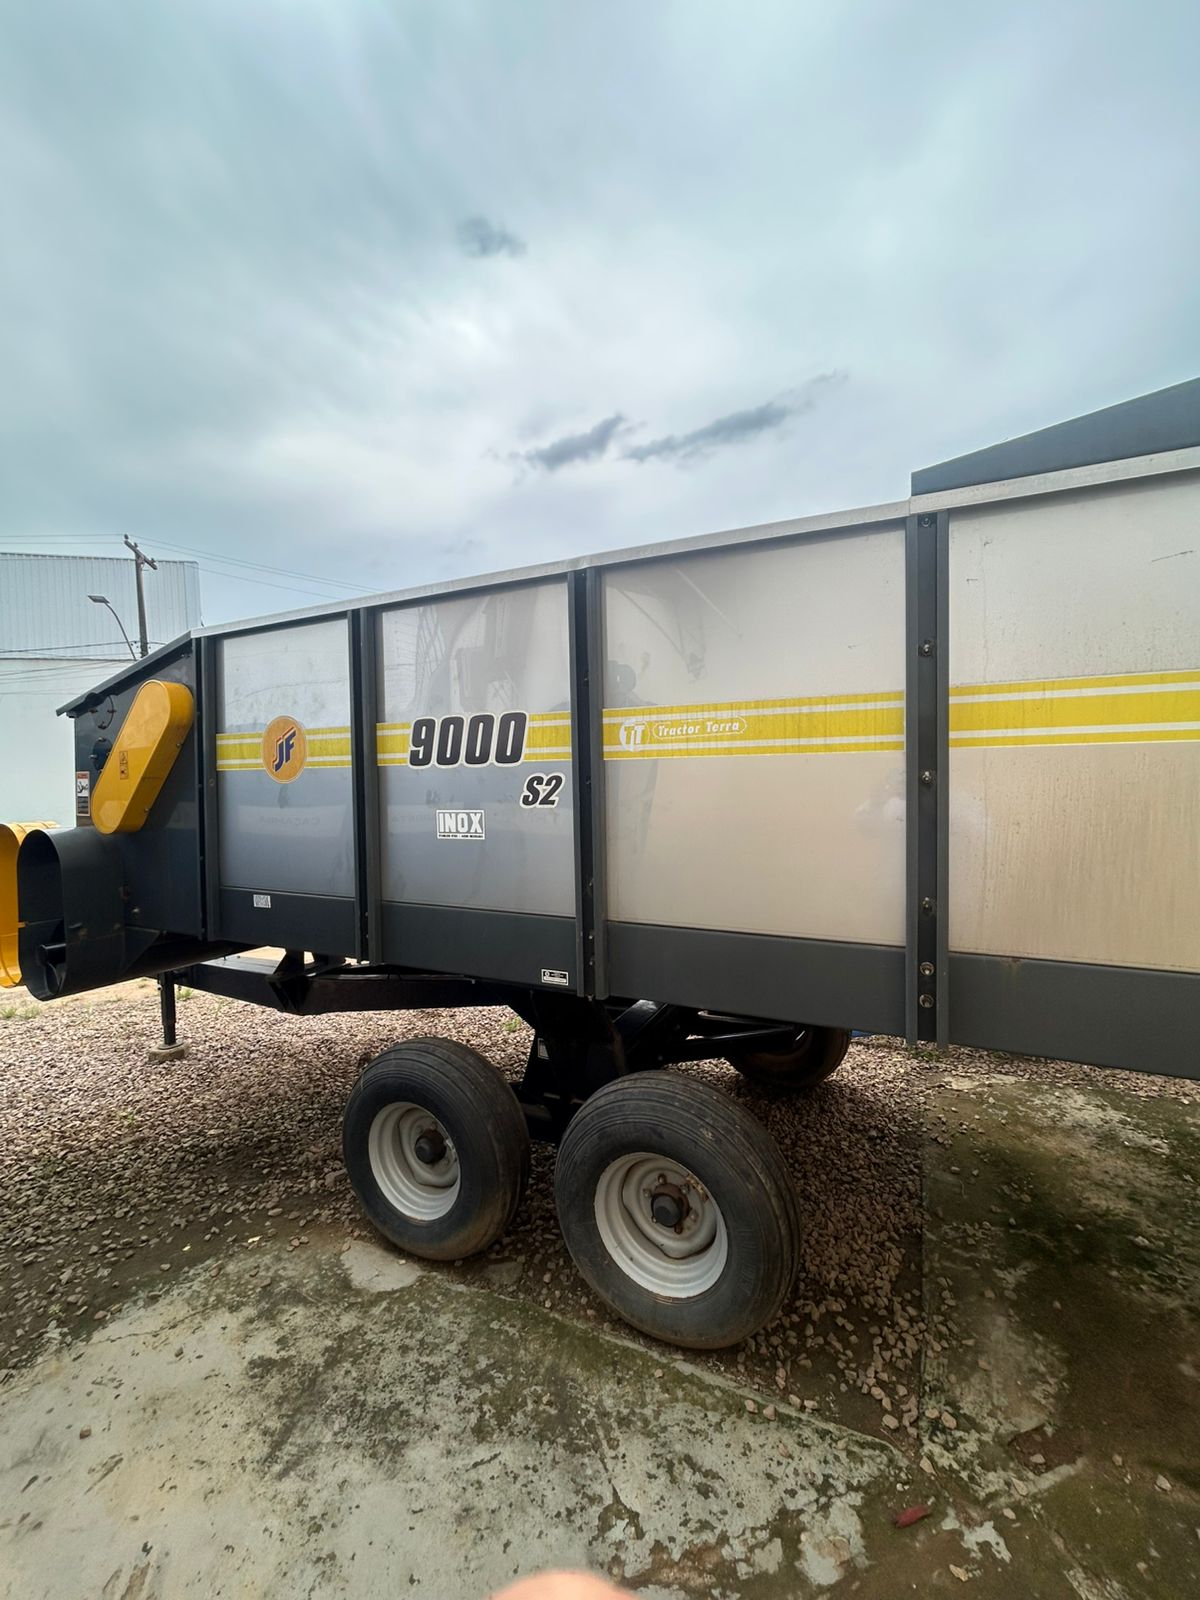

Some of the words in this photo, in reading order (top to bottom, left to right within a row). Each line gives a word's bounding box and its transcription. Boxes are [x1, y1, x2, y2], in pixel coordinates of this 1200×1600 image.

[409, 711, 527, 767] 9000
[658, 724, 700, 737] Tractor
[706, 721, 740, 733] Terra
[272, 726, 297, 772] JF
[521, 774, 563, 806] S2
[438, 812, 483, 833] INOX
